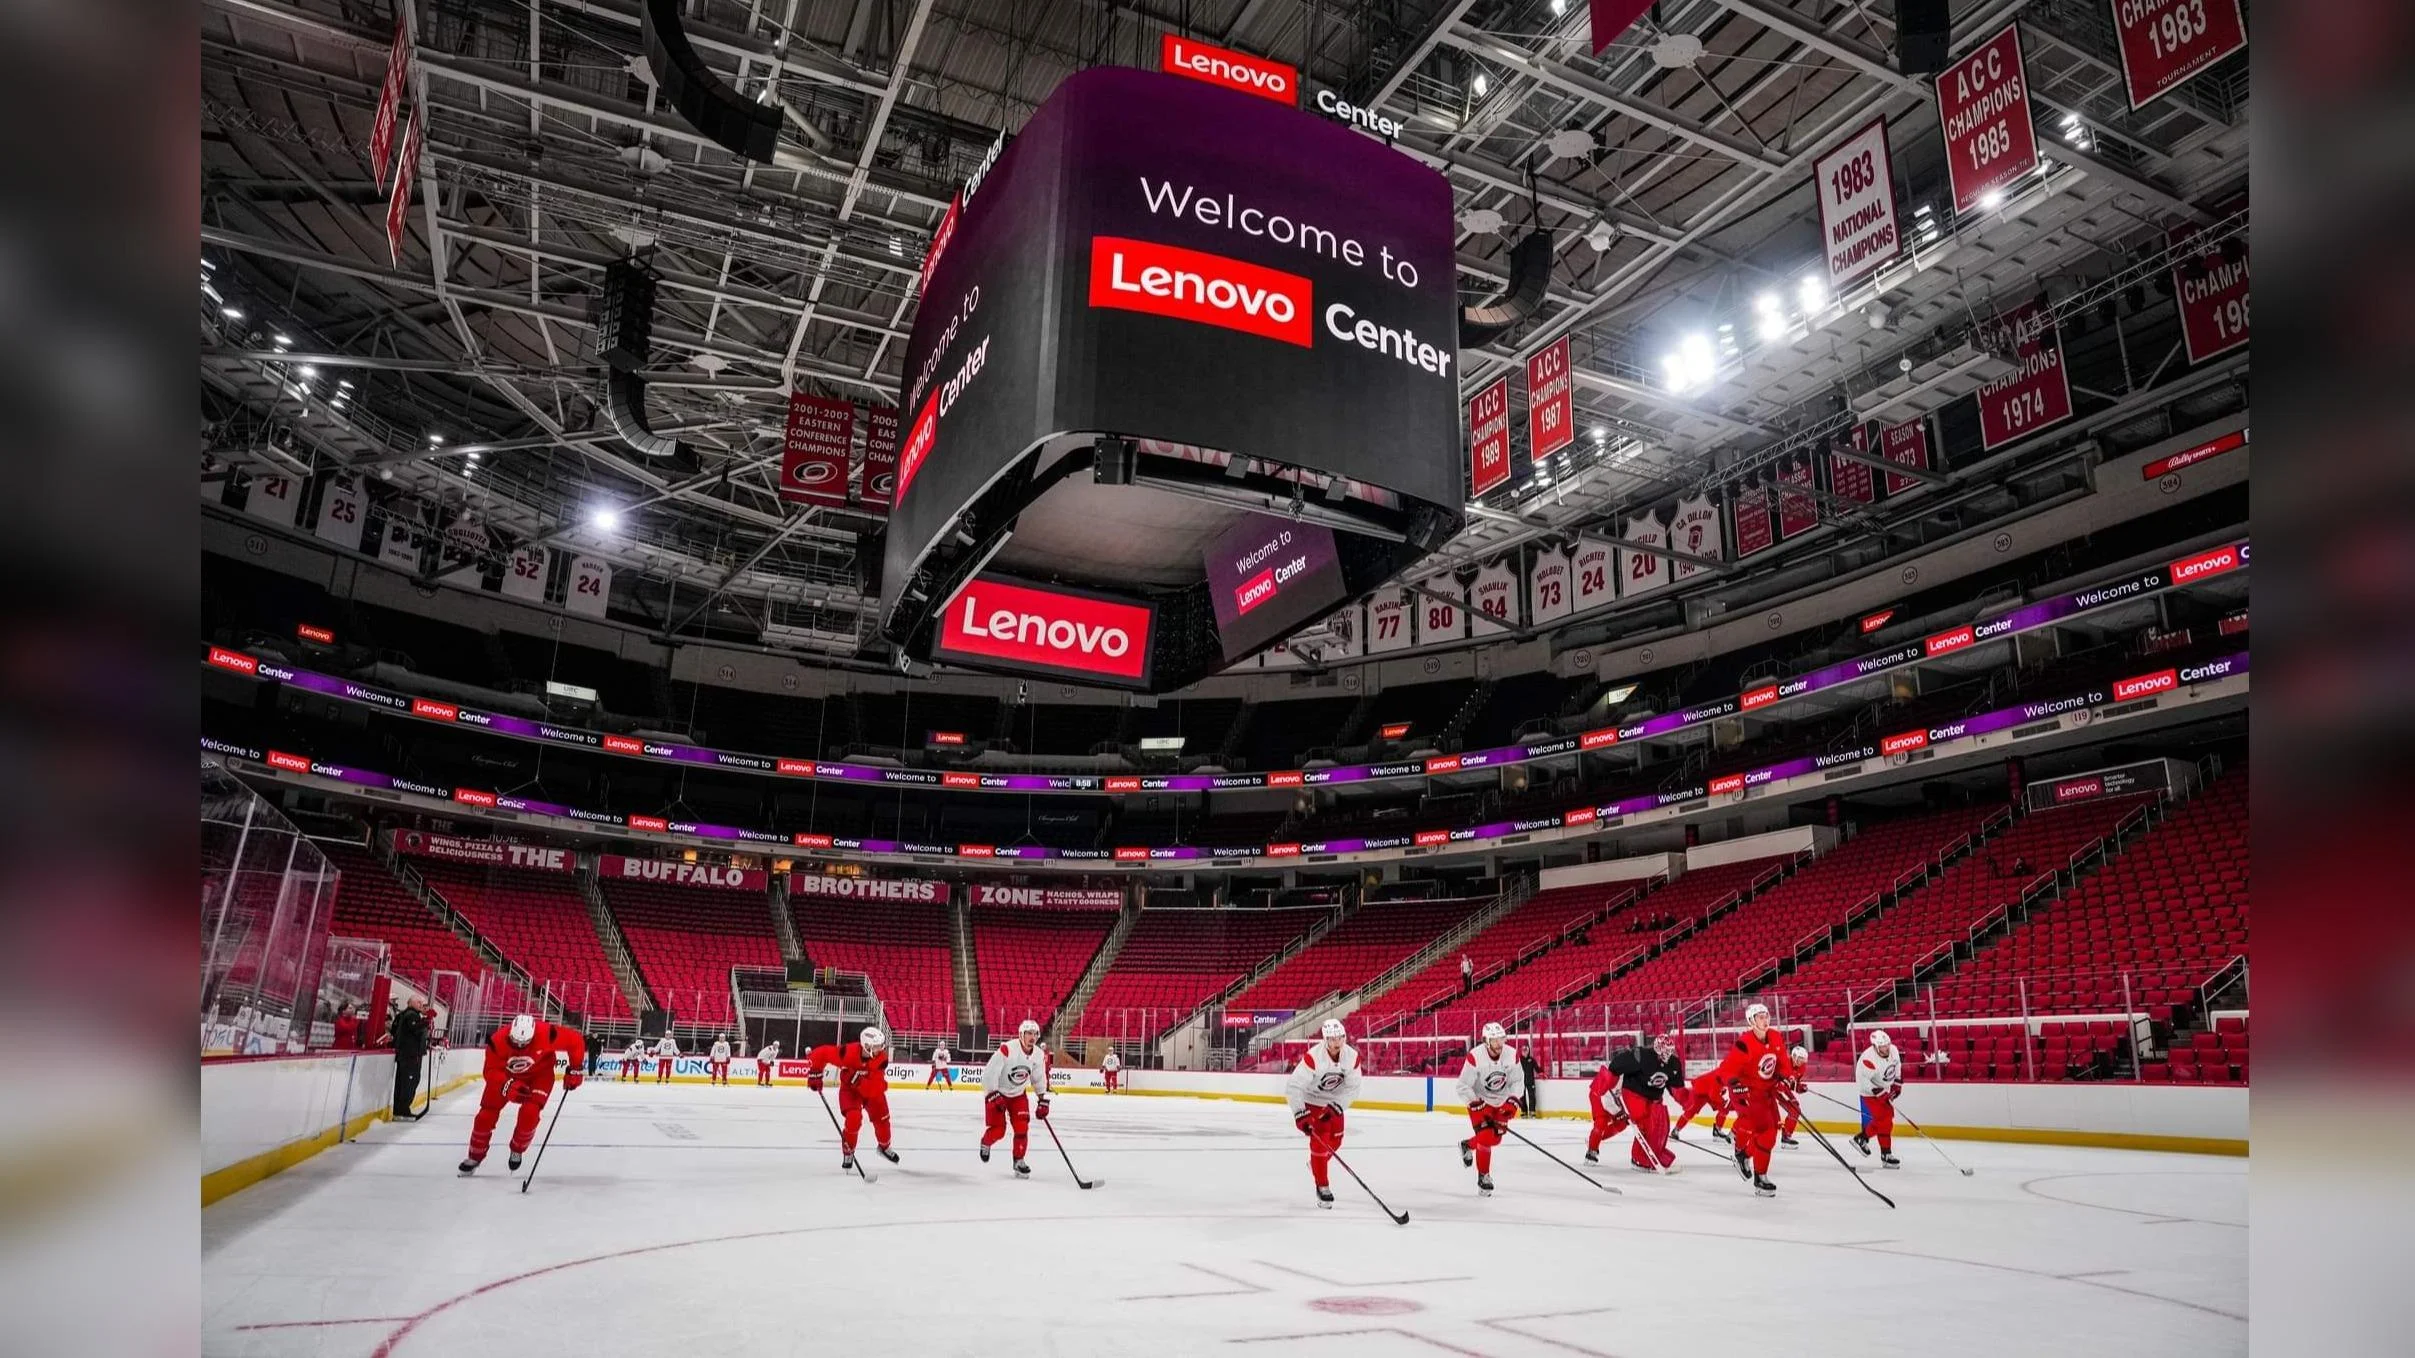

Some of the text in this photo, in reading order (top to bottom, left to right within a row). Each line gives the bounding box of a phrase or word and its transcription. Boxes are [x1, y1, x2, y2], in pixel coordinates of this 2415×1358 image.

[2150, 0, 2207, 59] 1983
[2157, 45, 2218, 89] TOURNAMENT
[1175, 44, 1405, 140] Lenovo Center
[1948, 76, 2021, 140] CHAMPIONS
[1969, 119, 2010, 171] 1985
[1831, 151, 1874, 204] 1983
[921, 127, 1006, 290] Lenovo Center
[1832, 198, 1886, 244] NATIONAL
[1140, 177, 1418, 288] Welcome to
[1832, 224, 1893, 276] CHAMPIONS
[1112, 253, 1451, 378] Lenovo Center
[909, 286, 979, 416] Welcome to
[1531, 372, 1568, 408] CHAMPIONS
[794, 403, 848, 420] 2001-2002
[899, 334, 990, 486] Lenovo Center
[1541, 401, 1561, 432] 1987
[2002, 387, 2044, 430] 1974
[791, 428, 846, 444] CONFERENCE
[800, 417, 840, 431] EASTERN
[1473, 412, 1505, 446] CHAMPIONS
[1890, 423, 1914, 446] SEASON
[789, 441, 846, 457] CHAMPIONS
[1481, 440, 1499, 468] 1989
[2168, 453, 2192, 471] Bally
[264, 477, 288, 500] 21
[2162, 478, 2179, 489] 324
[332, 499, 356, 523] 25
[1688, 510, 1713, 524] DILLON
[1236, 529, 1291, 578] Welcome to
[1579, 552, 1606, 568] RICHTER
[514, 558, 539, 580] 52
[1632, 554, 1656, 580] 20
[578, 575, 600, 596] 24
[1240, 555, 1305, 607] Lenovo Center
[1478, 580, 1508, 596] SHAVLIK
[1582, 566, 1604, 596] 24
[2076, 555, 2231, 609] Welcome to Lenovo
[1482, 596, 1507, 619] 84
[1540, 581, 1561, 610] 73
[963, 597, 1128, 657] Lenovo
[1378, 614, 1400, 640] 77
[1429, 606, 1452, 630] 80
[301, 626, 329, 640] Lenovo
[1857, 620, 2014, 674] Welcome to Lenovo Center
[214, 651, 293, 680] Lenovo Center
[720, 668, 734, 679] 314
[1683, 681, 1809, 723] Welcome to Lenovo Center
[2024, 661, 2233, 720] Welcome to Lenovo Center
[347, 686, 490, 724] Welcome to Lenovo Center
[2073, 711, 2088, 722] 119
[539, 726, 673, 755] Welcome to Lenovo Center
[937, 734, 962, 742] Lenovo
[1528, 743, 1564, 756] Welcome
[1584, 733, 1614, 745] Lenovo
[1619, 726, 1644, 738] Center
[1816, 725, 1965, 768] Welcome to Lenovo Center
[249, 749, 260, 759] to
[271, 753, 306, 769] Lenovo
[311, 763, 343, 776] Center
[719, 754, 759, 767] Welcome
[781, 762, 811, 772] Lenovo
[816, 766, 843, 775] Center
[1371, 767, 1409, 775] Welcome
[1429, 760, 1457, 770] Lenovo
[1461, 756, 1487, 765] Center
[1213, 778, 1250, 786] Welcome
[1304, 773, 1330, 781] Center
[1658, 771, 1772, 804] Welcome to Lenovo Center
[2060, 784, 2097, 797] Lenovo
[391, 778, 526, 809] Welcome to Lenovo Center
[570, 809, 696, 832] Welcome to Lenovo Center
[1514, 820, 1549, 830] Welcome
[1568, 812, 1593, 823] Lenovo
[1597, 806, 1619, 816] Center
[432, 836, 463, 848] WINGS,
[465, 843, 493, 852] PIZZA
[739, 830, 860, 847] Welcome to Lenovo Center
[1365, 839, 1399, 848] Welcome
[1418, 834, 1446, 843] Lenovo
[1450, 831, 1475, 839] Center
[429, 845, 504, 861] DELICIOUSNESS
[508, 846, 565, 868] THE
[624, 858, 743, 886] BUFFALO
[804, 874, 935, 899] BROTHERS
[981, 886, 1044, 906] ZONE
[1047, 890, 1119, 900] NACHOS, WRAPS
[1224, 1015, 1277, 1024] Lenovo Center
[886, 1067, 916, 1080] align
